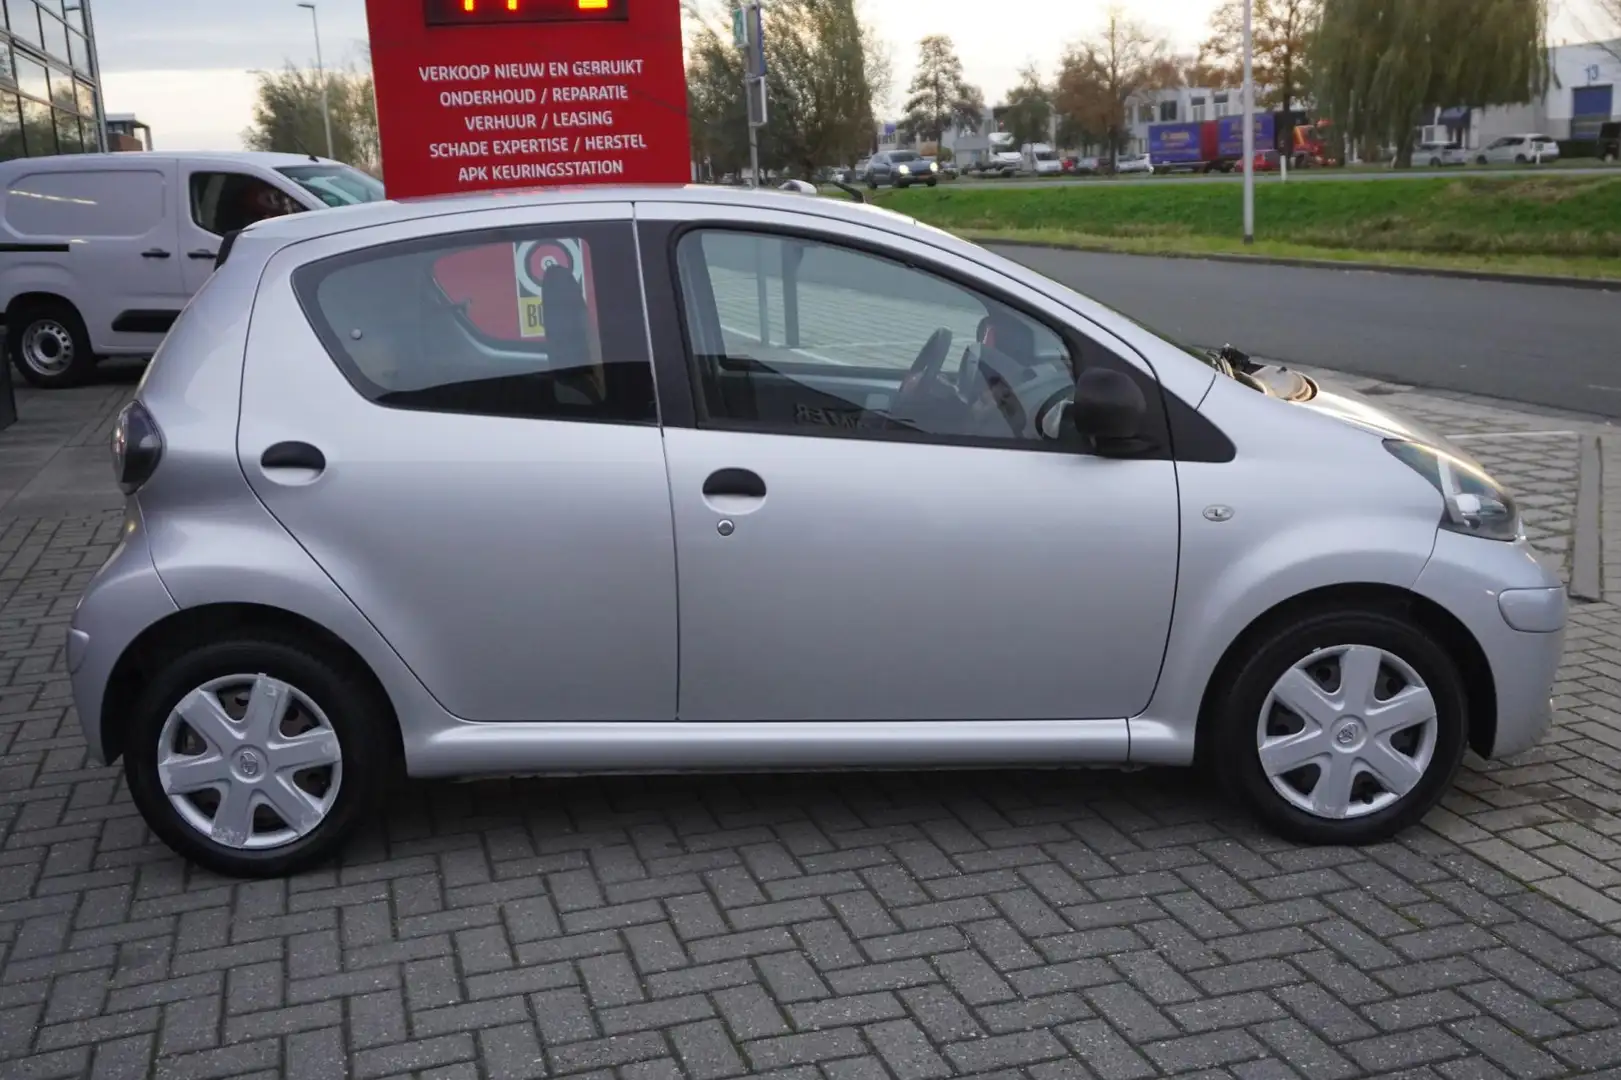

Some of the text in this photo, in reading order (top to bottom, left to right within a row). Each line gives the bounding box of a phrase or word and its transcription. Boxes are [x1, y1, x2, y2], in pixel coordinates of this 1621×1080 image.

[419, 59, 644, 81] VERKOOP NIEUW EN GEBRUIKT
[440, 85, 628, 107] ONDERHOUD / REPARATIE
[465, 111, 613, 131] VERHUUR / LEASING
[430, 134, 646, 158] SCHADE EXPERTISE / HERSTEL
[459, 160, 623, 182] APK KEURINGSSTATION
